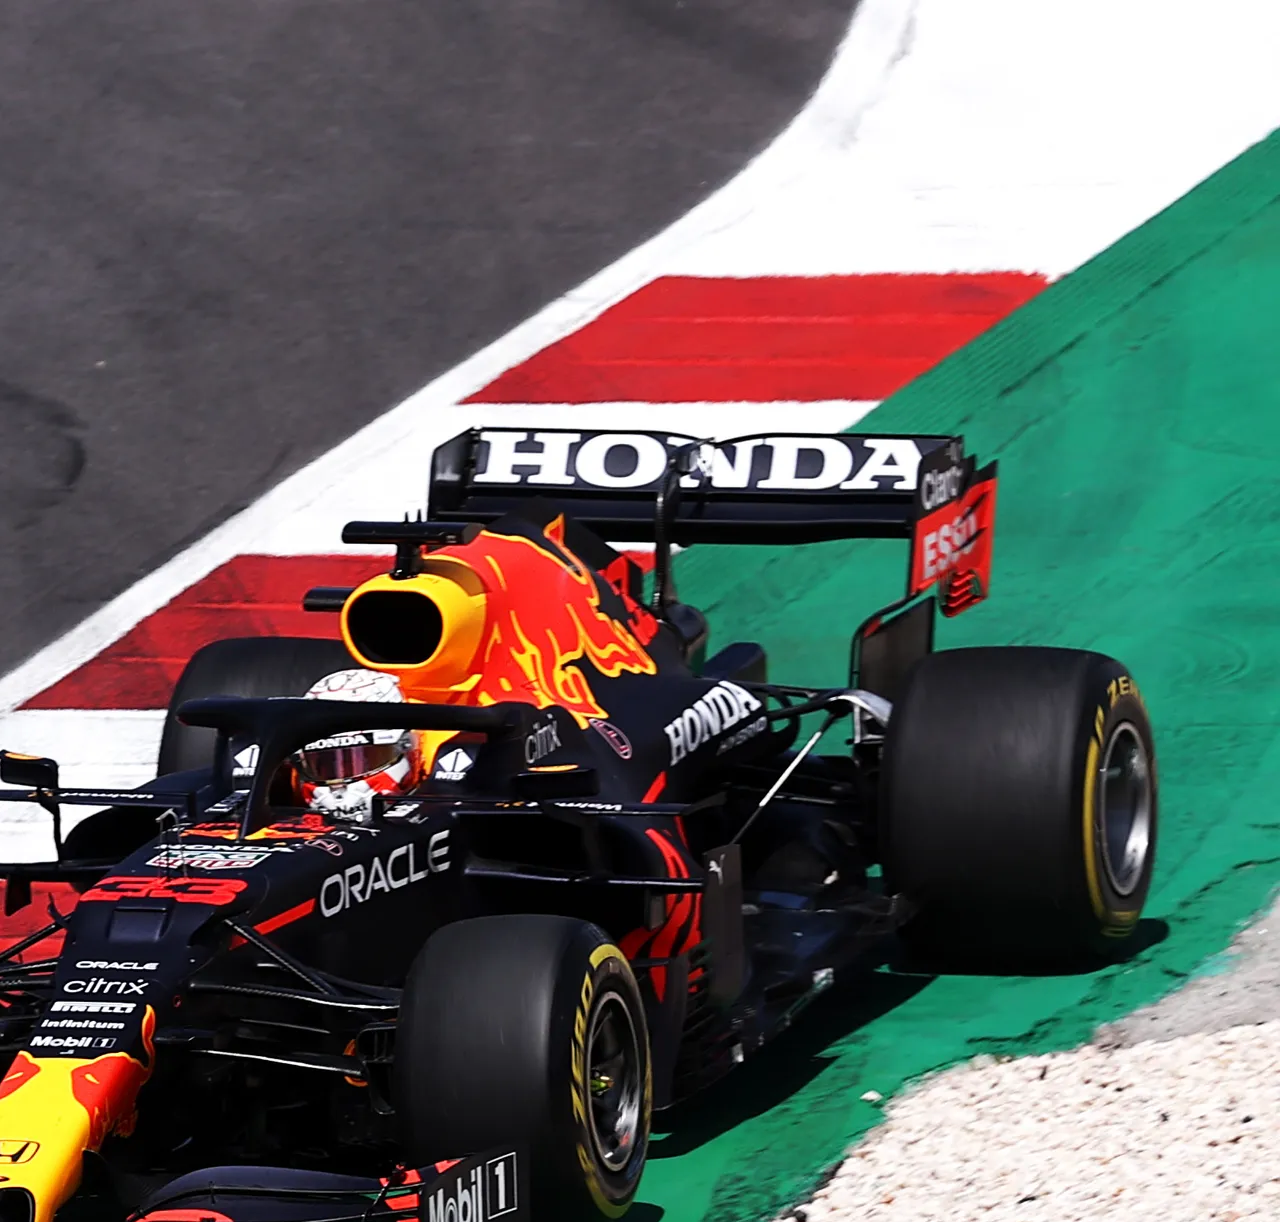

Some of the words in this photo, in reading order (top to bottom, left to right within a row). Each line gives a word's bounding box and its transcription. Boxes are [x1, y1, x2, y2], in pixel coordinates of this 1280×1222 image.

[474, 432, 922, 490] HONDA
[663, 680, 762, 767] HONDA
[319, 829, 452, 919] ORACLE
[80, 876, 248, 908] 33
[75, 959, 160, 971] ORACLE
[62, 977, 149, 996] citrix
[50, 1001, 137, 1014] PIRELLI
[29, 1035, 93, 1049] Mobil
